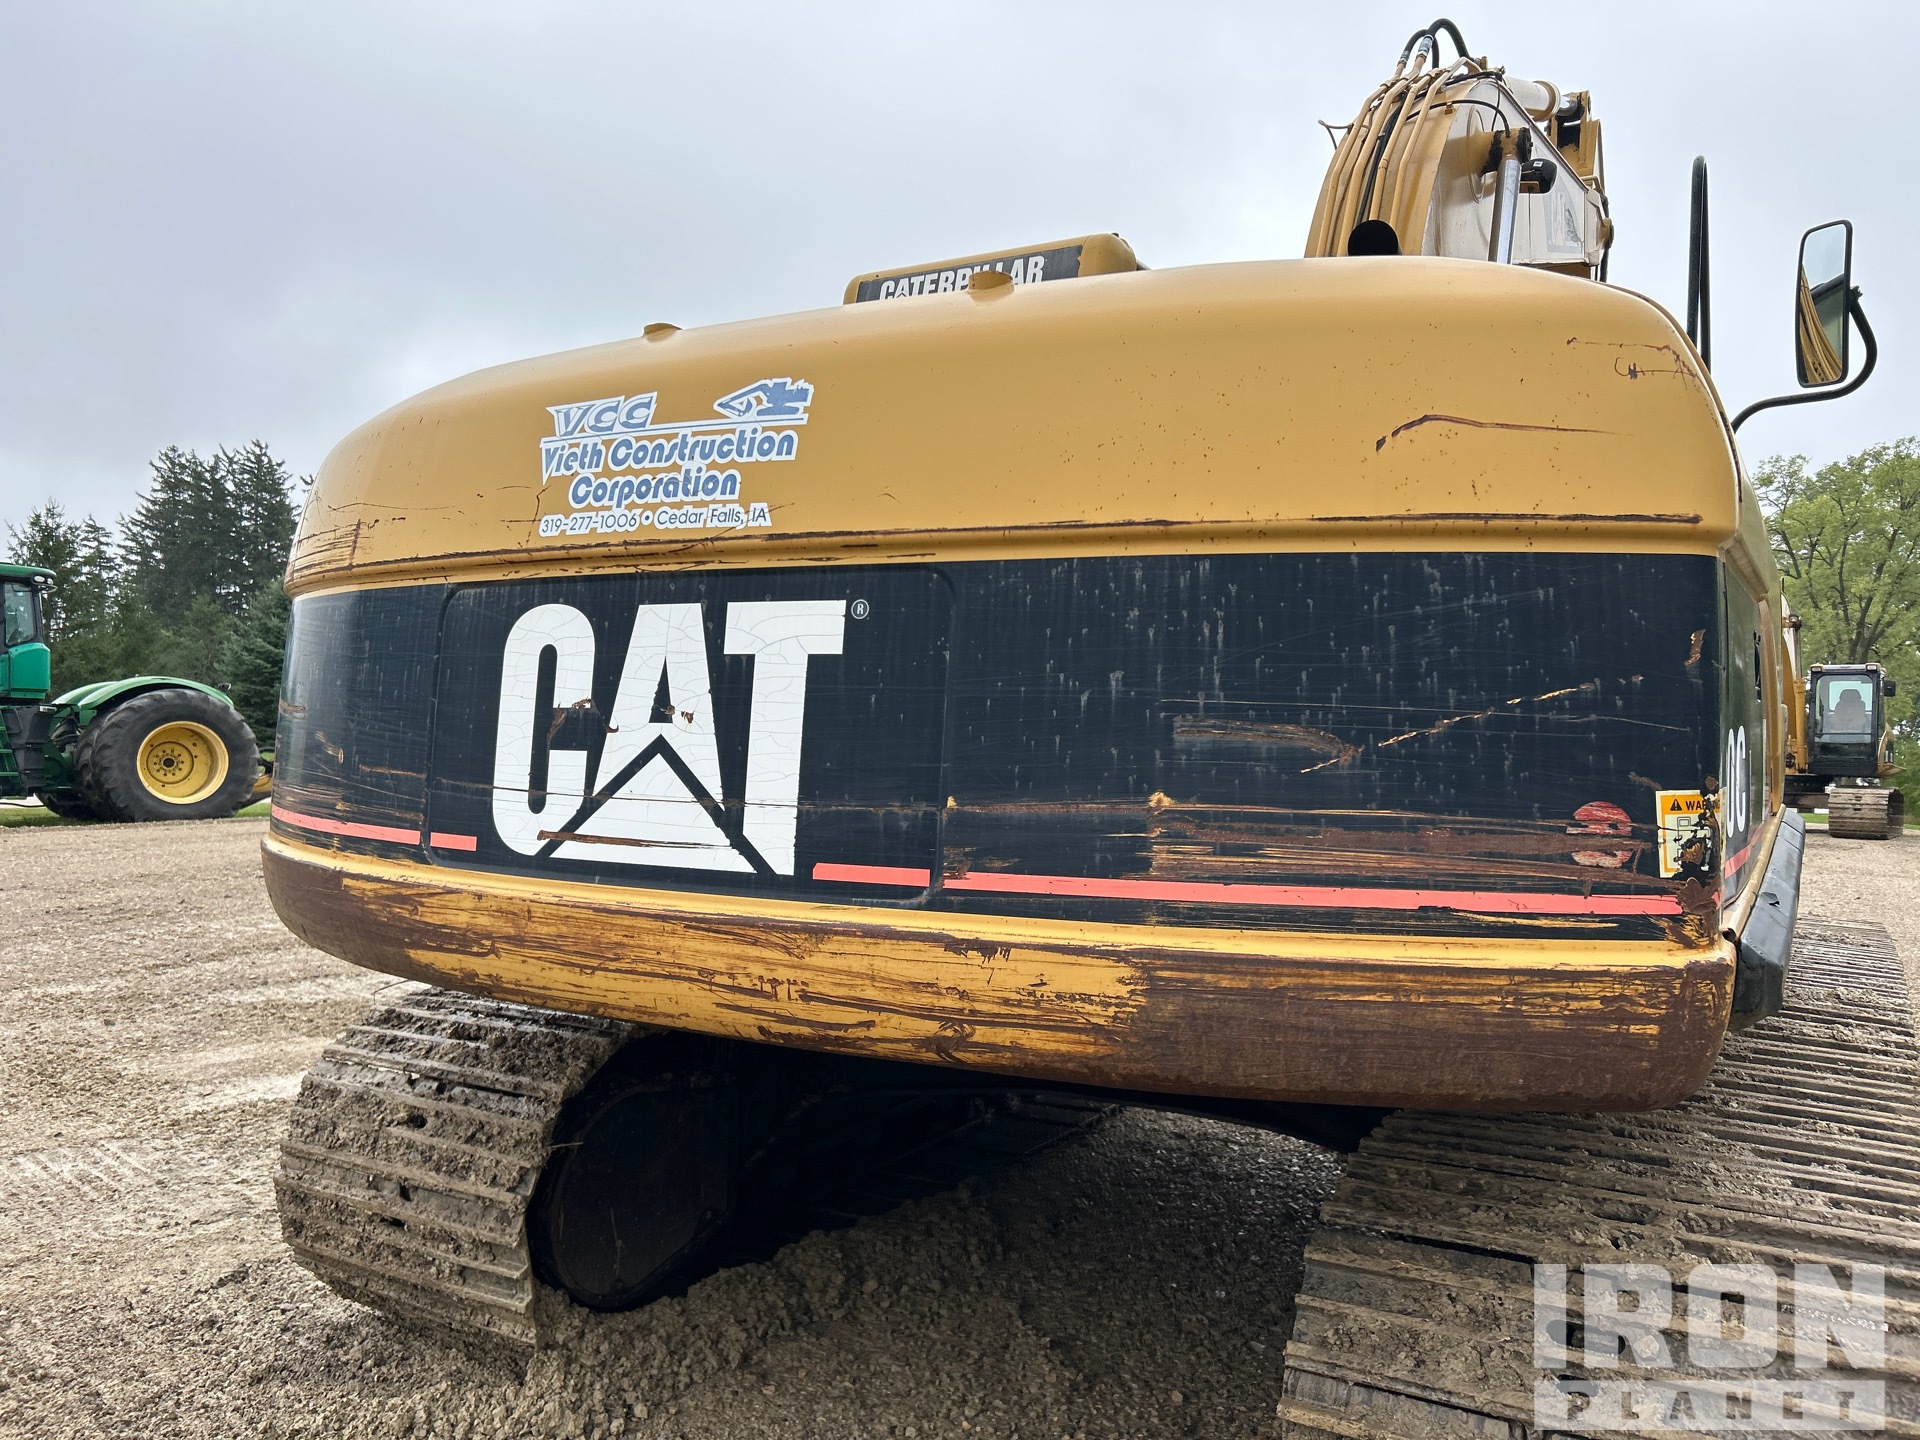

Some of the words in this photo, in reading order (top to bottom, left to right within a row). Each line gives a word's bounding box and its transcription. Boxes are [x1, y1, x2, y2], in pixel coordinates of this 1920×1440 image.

[553, 392, 656, 437] VCC
[545, 440, 603, 478] Vieth
[611, 428, 794, 468] Construction
[572, 463, 738, 508] Corporation
[541, 513, 637, 534] 319-277-1006
[656, 509, 704, 526] Cedar
[709, 507, 746, 526] Falls,
[751, 507, 768, 523] IA
[493, 600, 846, 875] CAT
